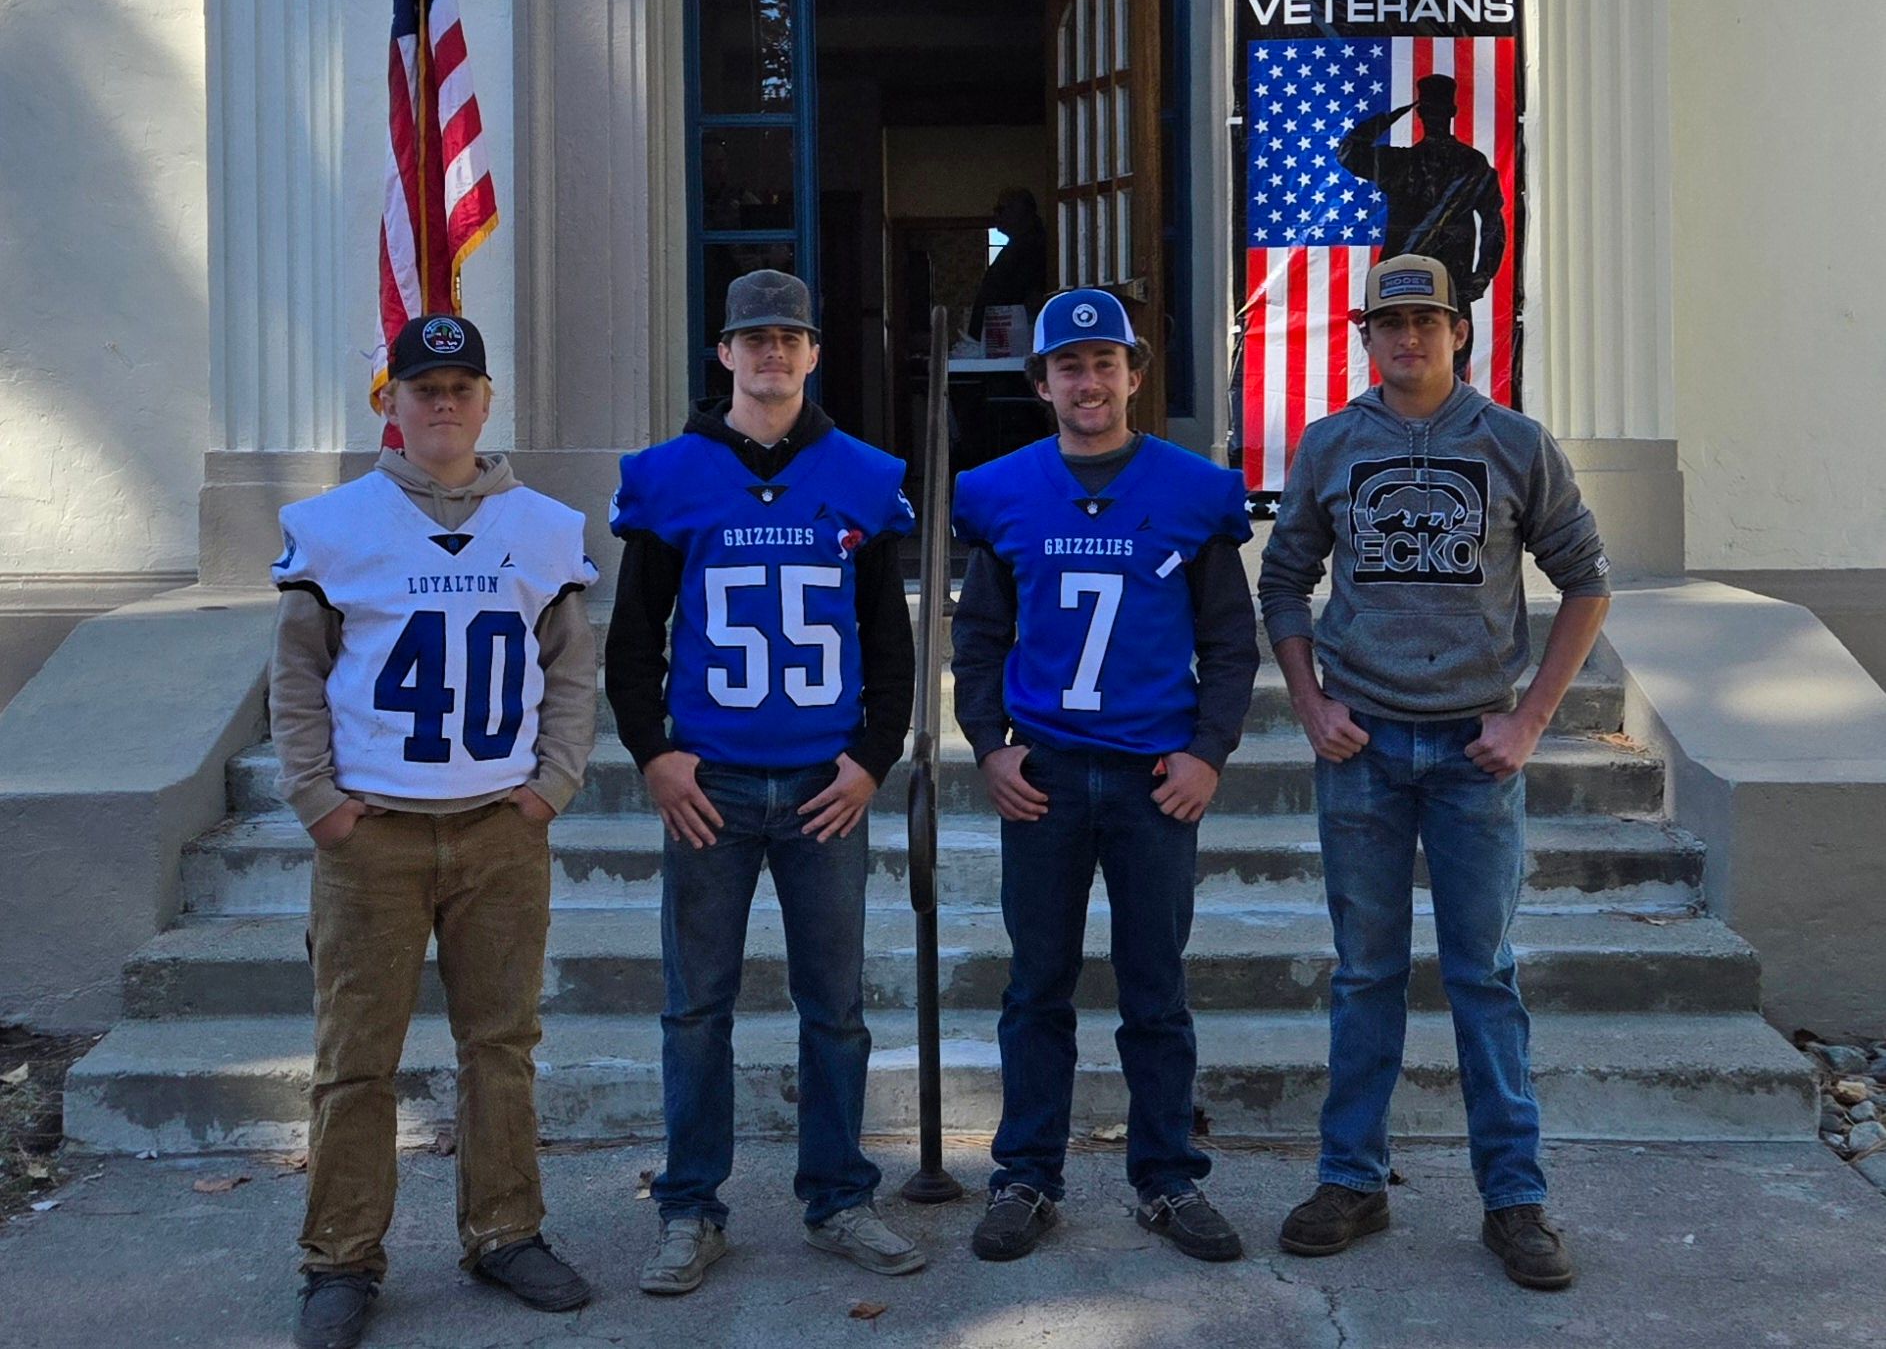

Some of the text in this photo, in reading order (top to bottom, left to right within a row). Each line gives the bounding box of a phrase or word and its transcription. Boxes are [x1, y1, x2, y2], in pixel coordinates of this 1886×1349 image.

[723, 527, 815, 547] GRIZZLIES
[1044, 538, 1133, 557] GRIZZLIES
[1355, 533, 1481, 574] ECKO
[408, 575, 499, 595] LOYALTON
[704, 565, 844, 709] 55
[1059, 571, 1124, 712] 7
[373, 610, 528, 764] 40
